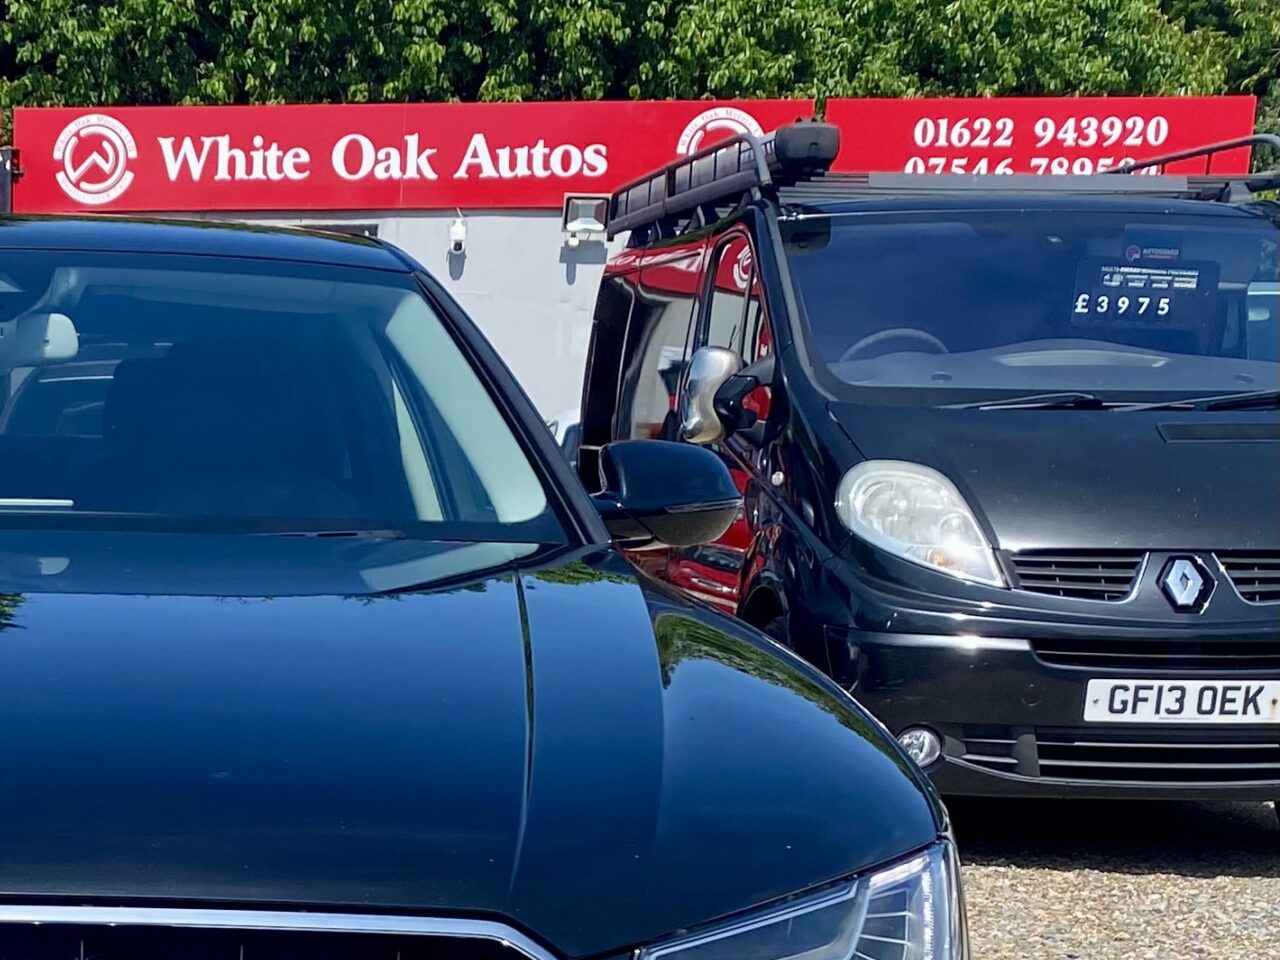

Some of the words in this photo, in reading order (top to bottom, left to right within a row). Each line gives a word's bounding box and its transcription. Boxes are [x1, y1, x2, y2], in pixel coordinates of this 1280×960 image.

[913, 117, 1015, 148] 01622
[1033, 116, 1169, 148] 943920
[157, 132, 310, 181] White
[331, 132, 438, 181] Oak
[453, 132, 608, 179] Autos
[1108, 684, 1187, 715] GF13
[1196, 685, 1266, 716] OEK
